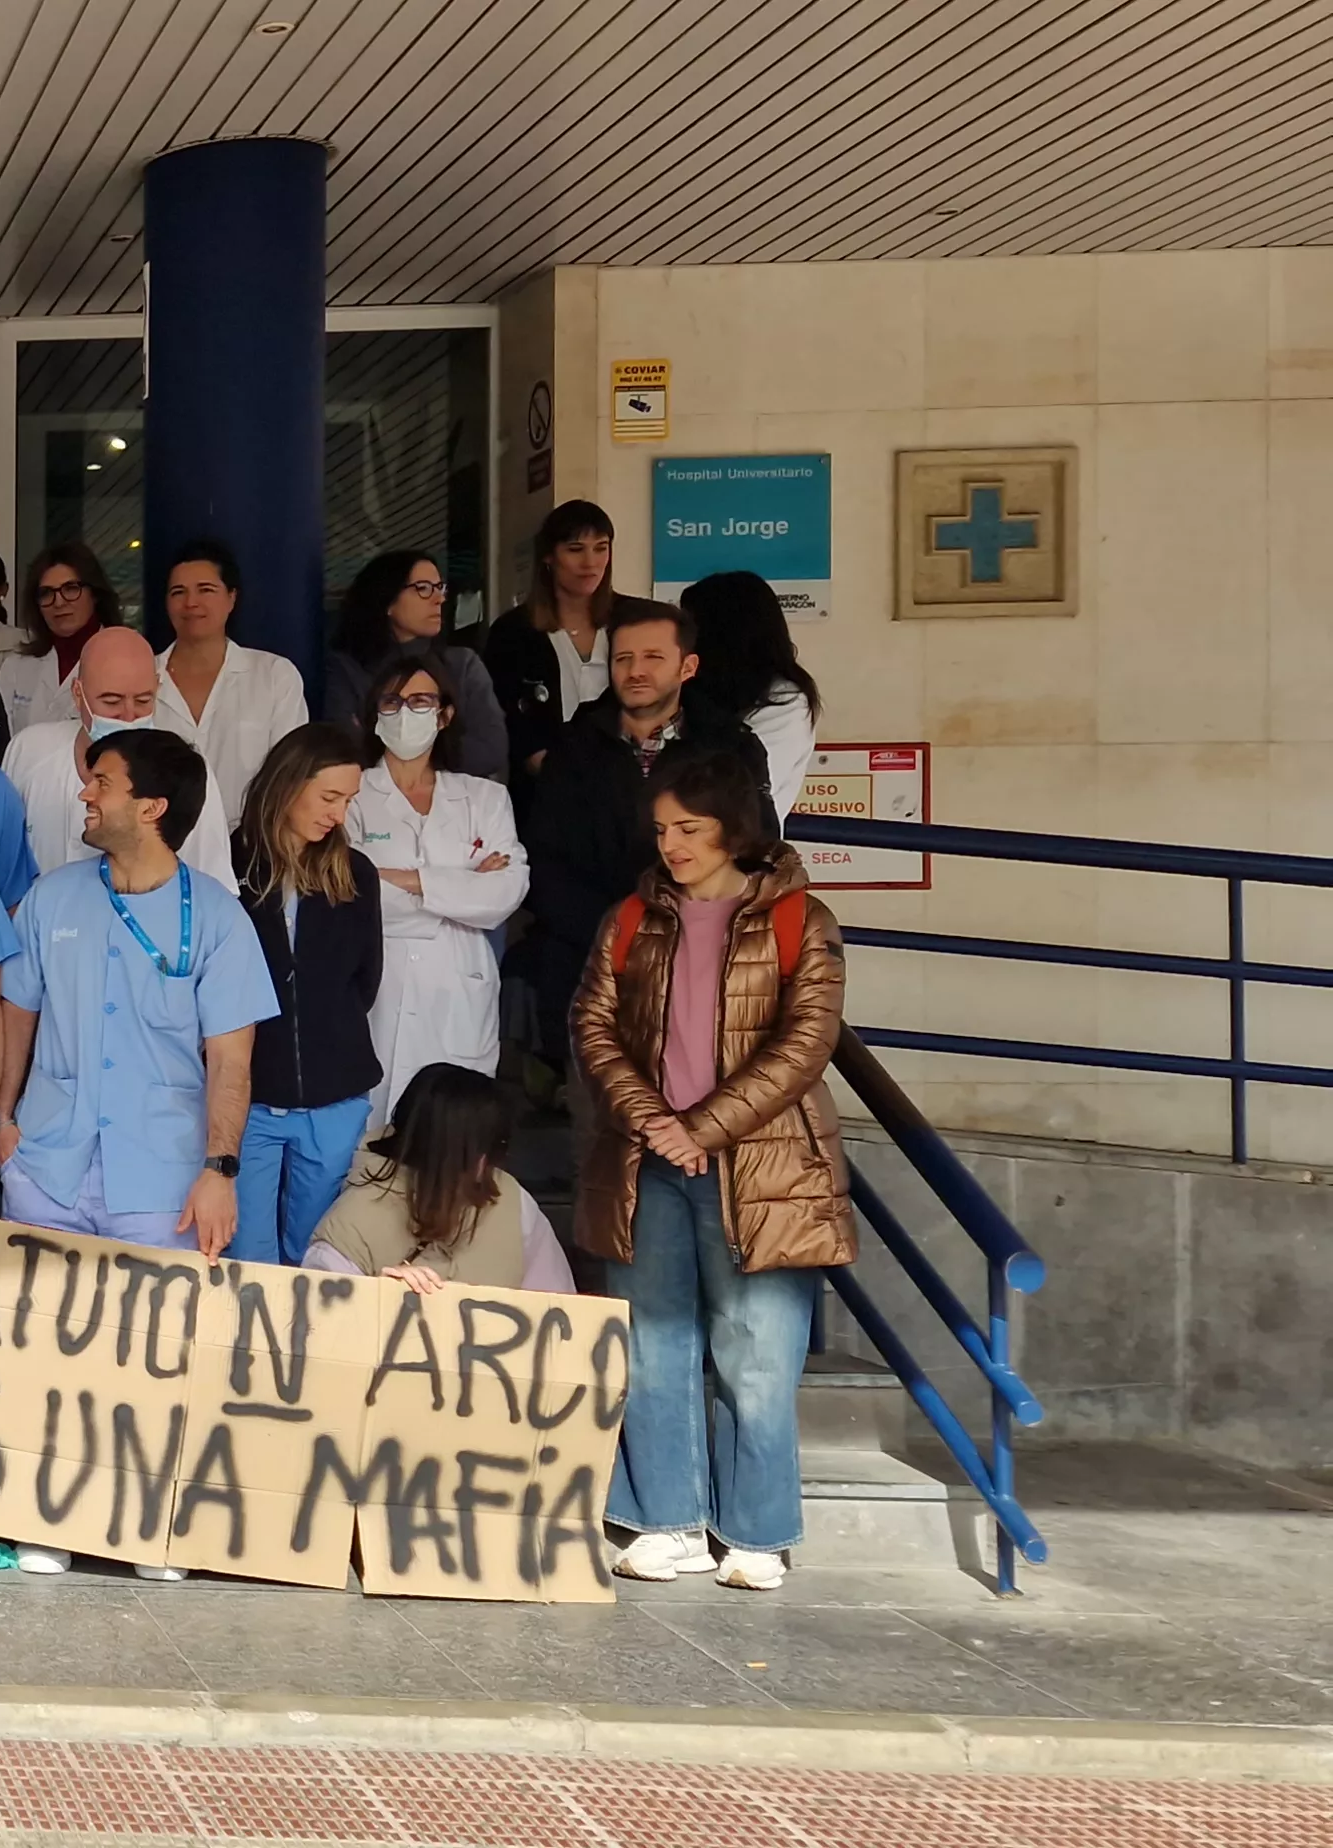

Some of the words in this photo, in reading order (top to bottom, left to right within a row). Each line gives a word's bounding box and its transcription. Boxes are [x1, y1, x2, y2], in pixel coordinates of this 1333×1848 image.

[624, 365, 666, 375] COVIAR
[667, 468, 722, 482] Hospital
[727, 467, 813, 480] Universitario
[666, 518, 712, 537] San
[721, 518, 789, 540] Jorge
[806, 785, 838, 795] USO
[790, 802, 865, 813] XCLUSIVO
[812, 852, 852, 864] SECA
[364, 1291, 631, 1432] ARCO
[35, 1389, 246, 1560] UNA
